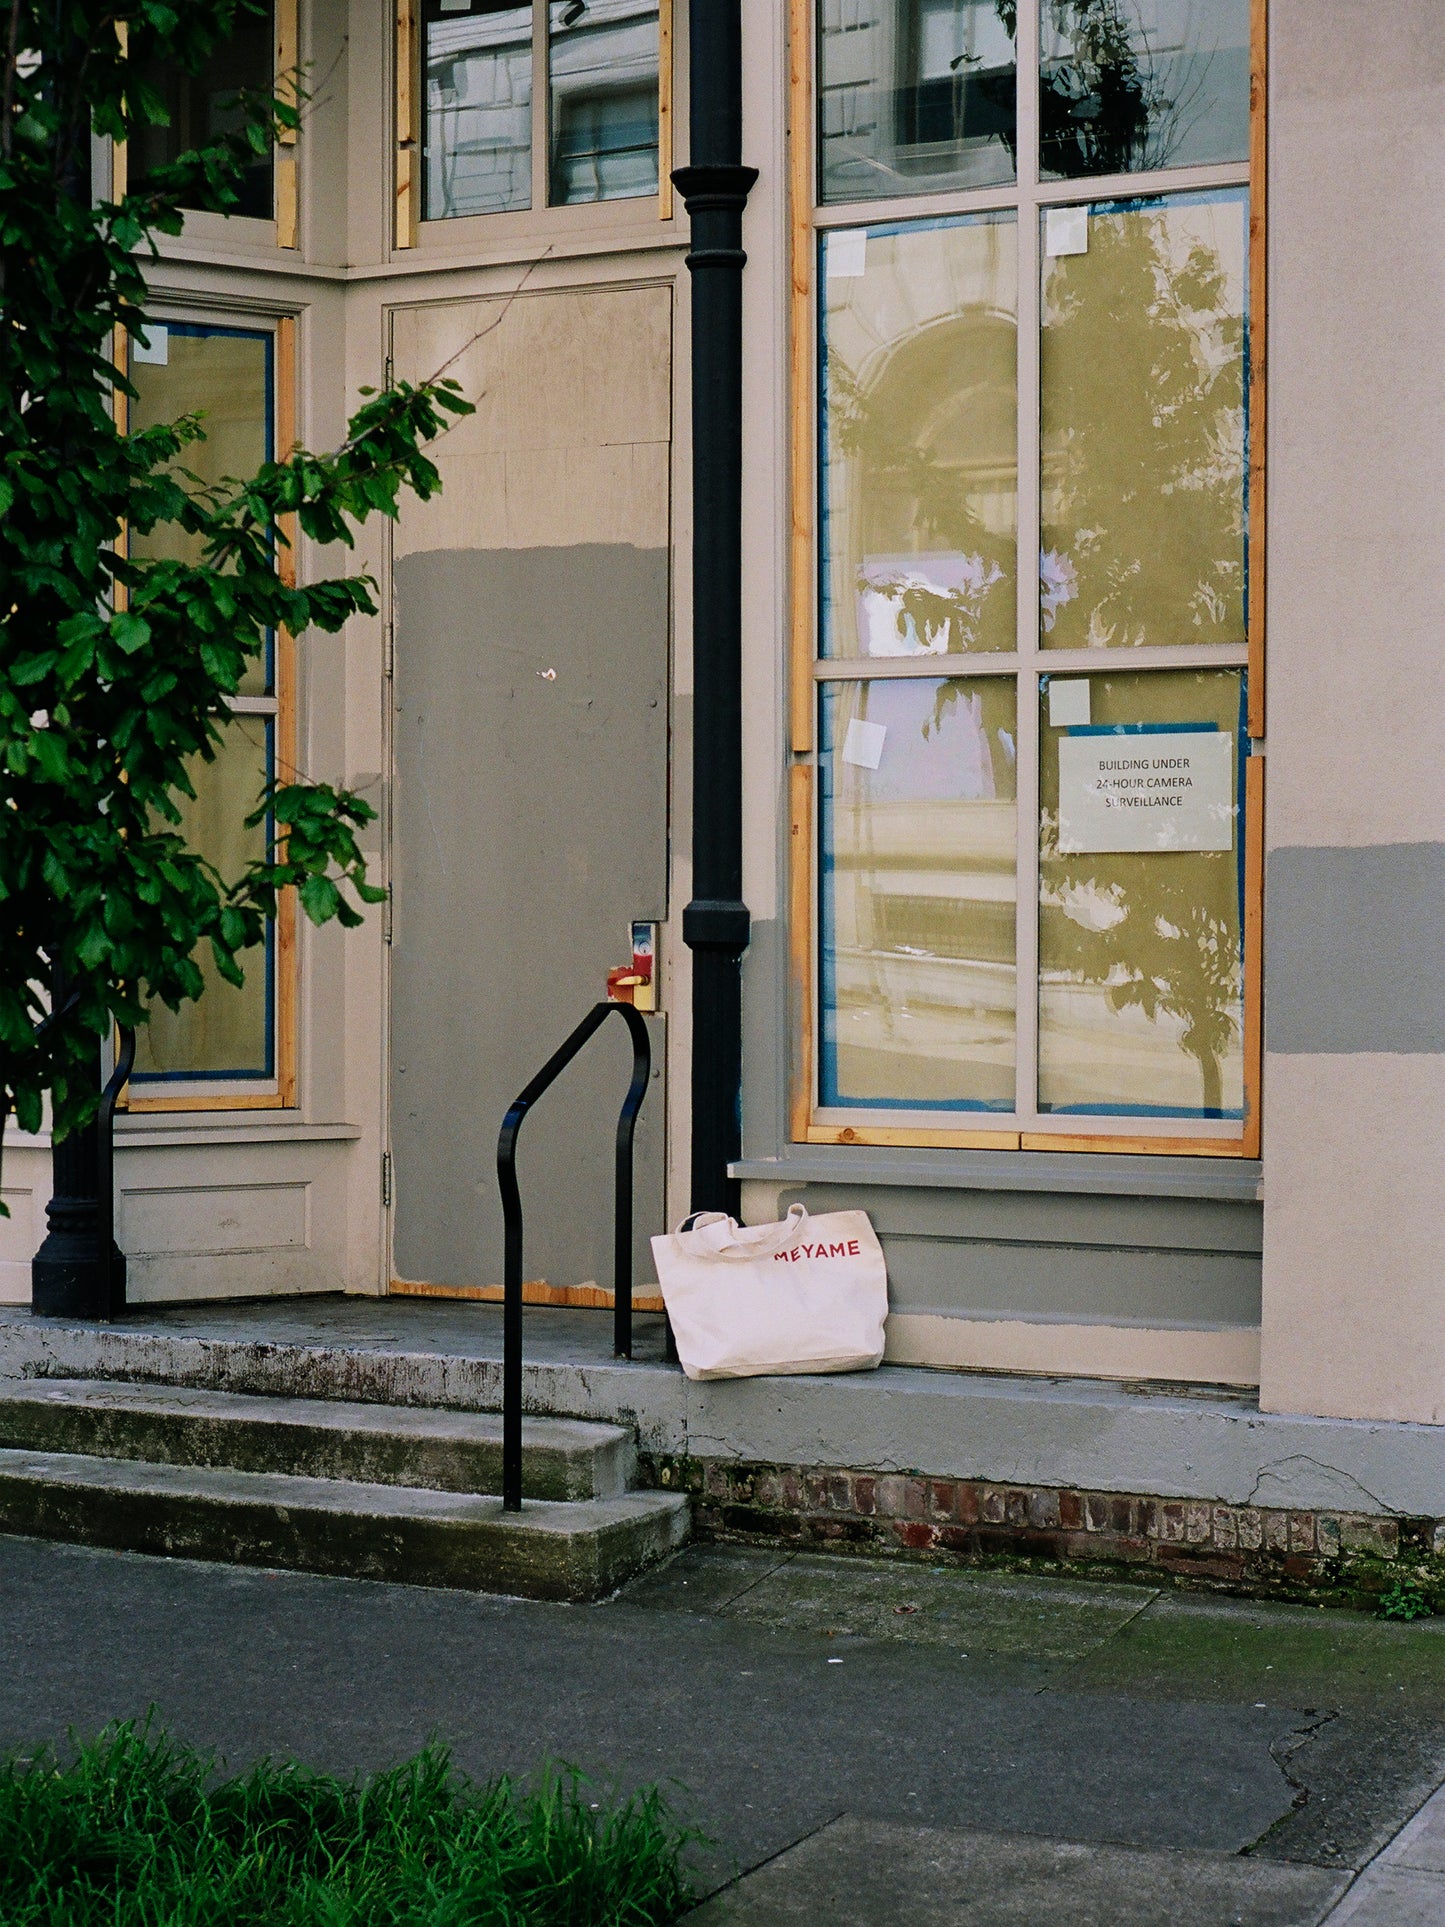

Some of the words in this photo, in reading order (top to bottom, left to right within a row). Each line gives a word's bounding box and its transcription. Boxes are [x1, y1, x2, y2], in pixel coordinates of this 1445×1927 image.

[1099, 759, 1149, 771] BUILDING
[1152, 758, 1190, 769] UNDER
[1096, 778, 1144, 789] 24-HOUR
[1146, 777, 1193, 788] CAMERA
[1105, 796, 1183, 808] SURVEILLANCE
[774, 1239, 861, 1263] MEYAME
